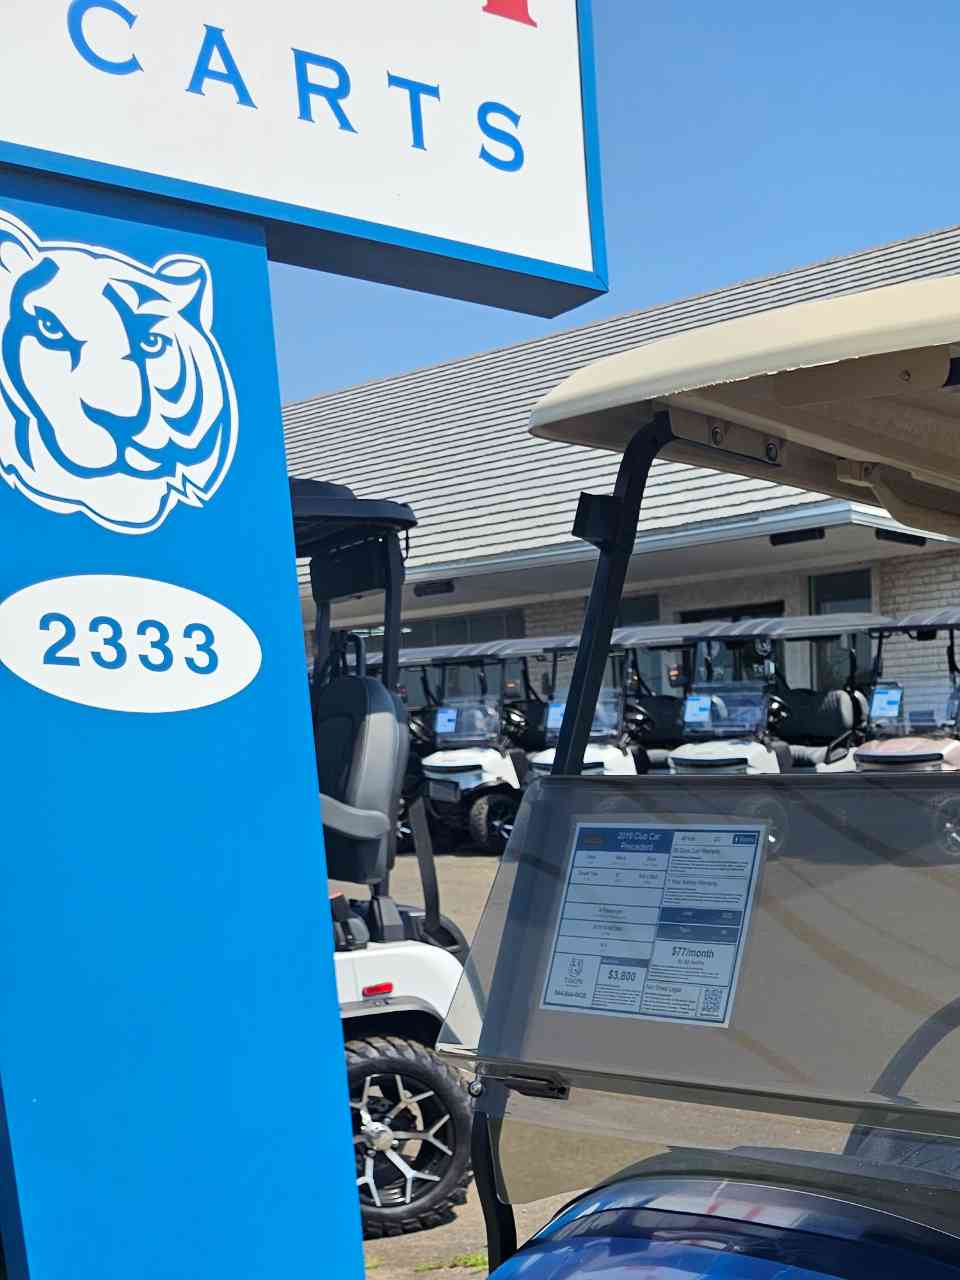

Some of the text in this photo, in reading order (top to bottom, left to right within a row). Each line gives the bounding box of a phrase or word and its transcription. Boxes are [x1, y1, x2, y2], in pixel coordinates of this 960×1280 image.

[67, 0, 524, 172] CARTS
[39, 612, 219, 675] 2333
[672, 946, 714, 959] $77/month
